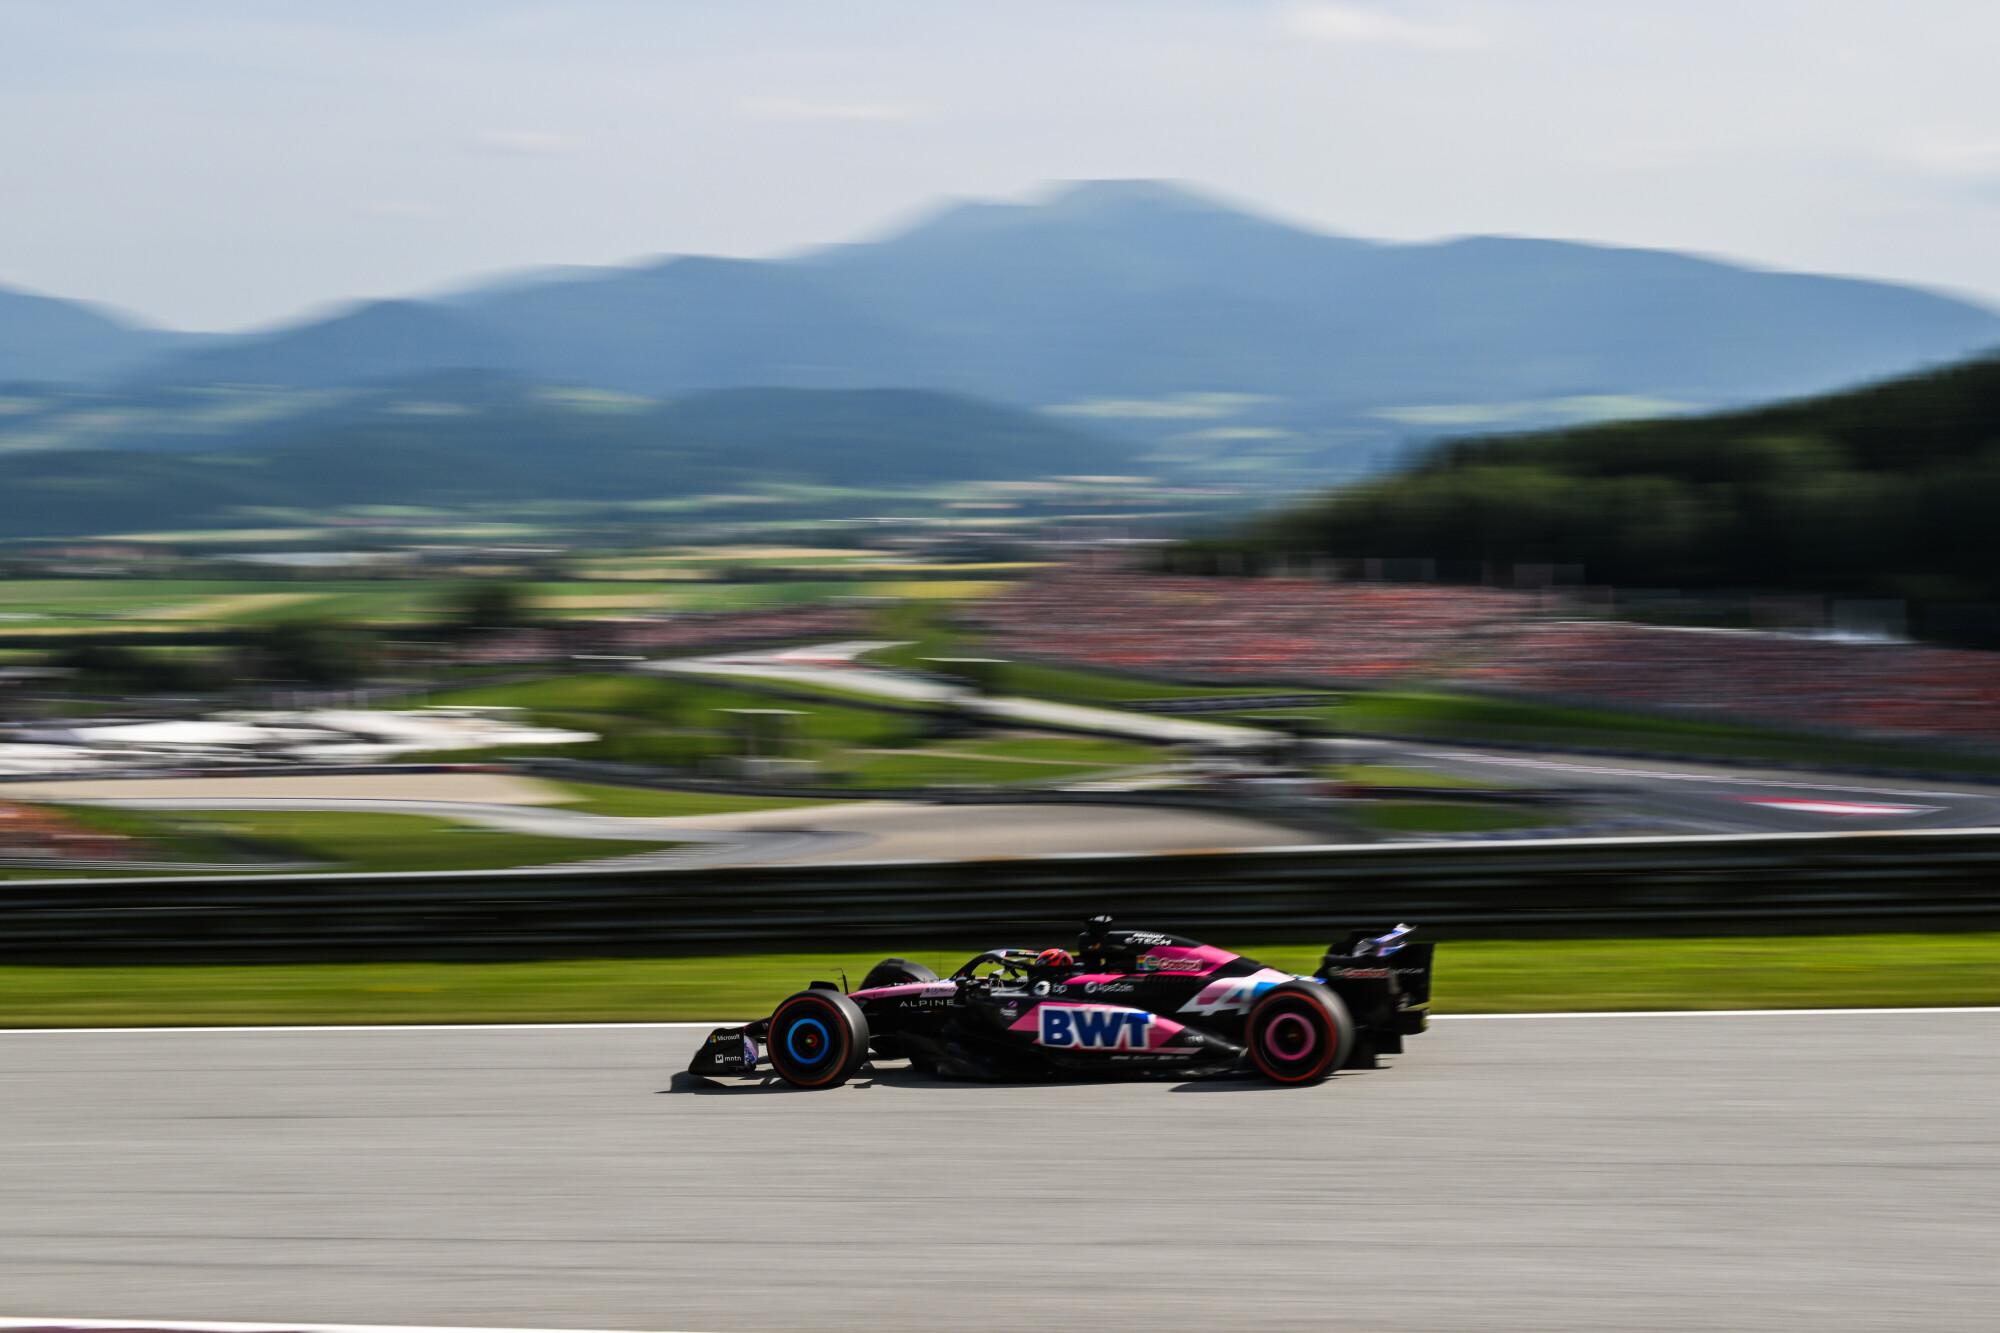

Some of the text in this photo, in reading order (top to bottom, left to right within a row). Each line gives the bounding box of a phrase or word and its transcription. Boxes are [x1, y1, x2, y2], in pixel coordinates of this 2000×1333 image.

[899, 1000, 954, 1008] ALPINE
[1040, 1006, 1154, 1050] BWT
[716, 1033, 741, 1041] Microsoft
